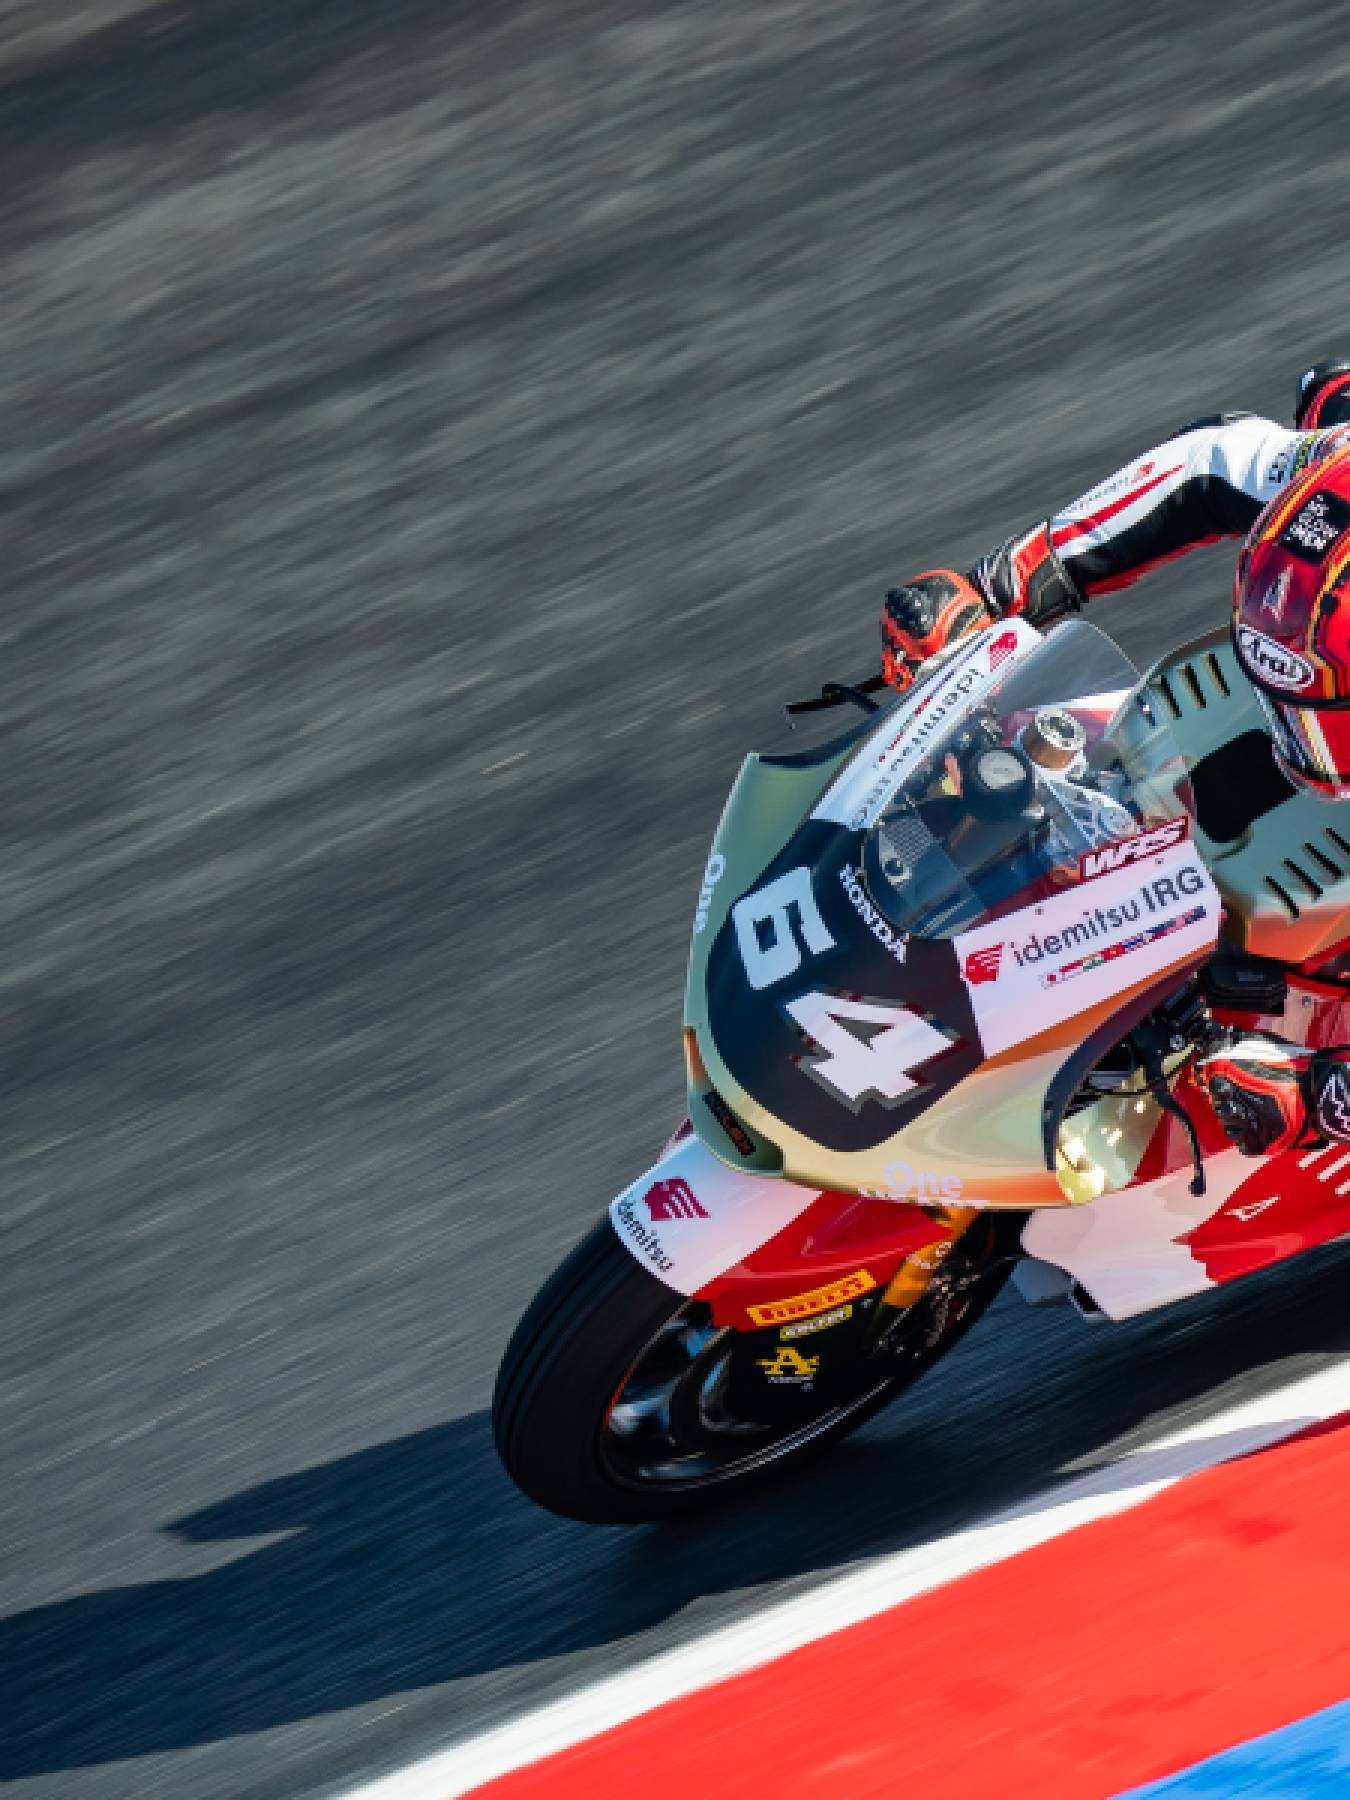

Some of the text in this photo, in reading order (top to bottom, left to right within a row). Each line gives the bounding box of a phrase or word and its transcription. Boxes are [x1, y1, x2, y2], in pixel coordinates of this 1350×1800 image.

[839, 863, 909, 964] HONDA
[1011, 866, 1207, 967] idemitsu IRG
[731, 865, 961, 1110] 64
[884, 1159, 963, 1199] One
